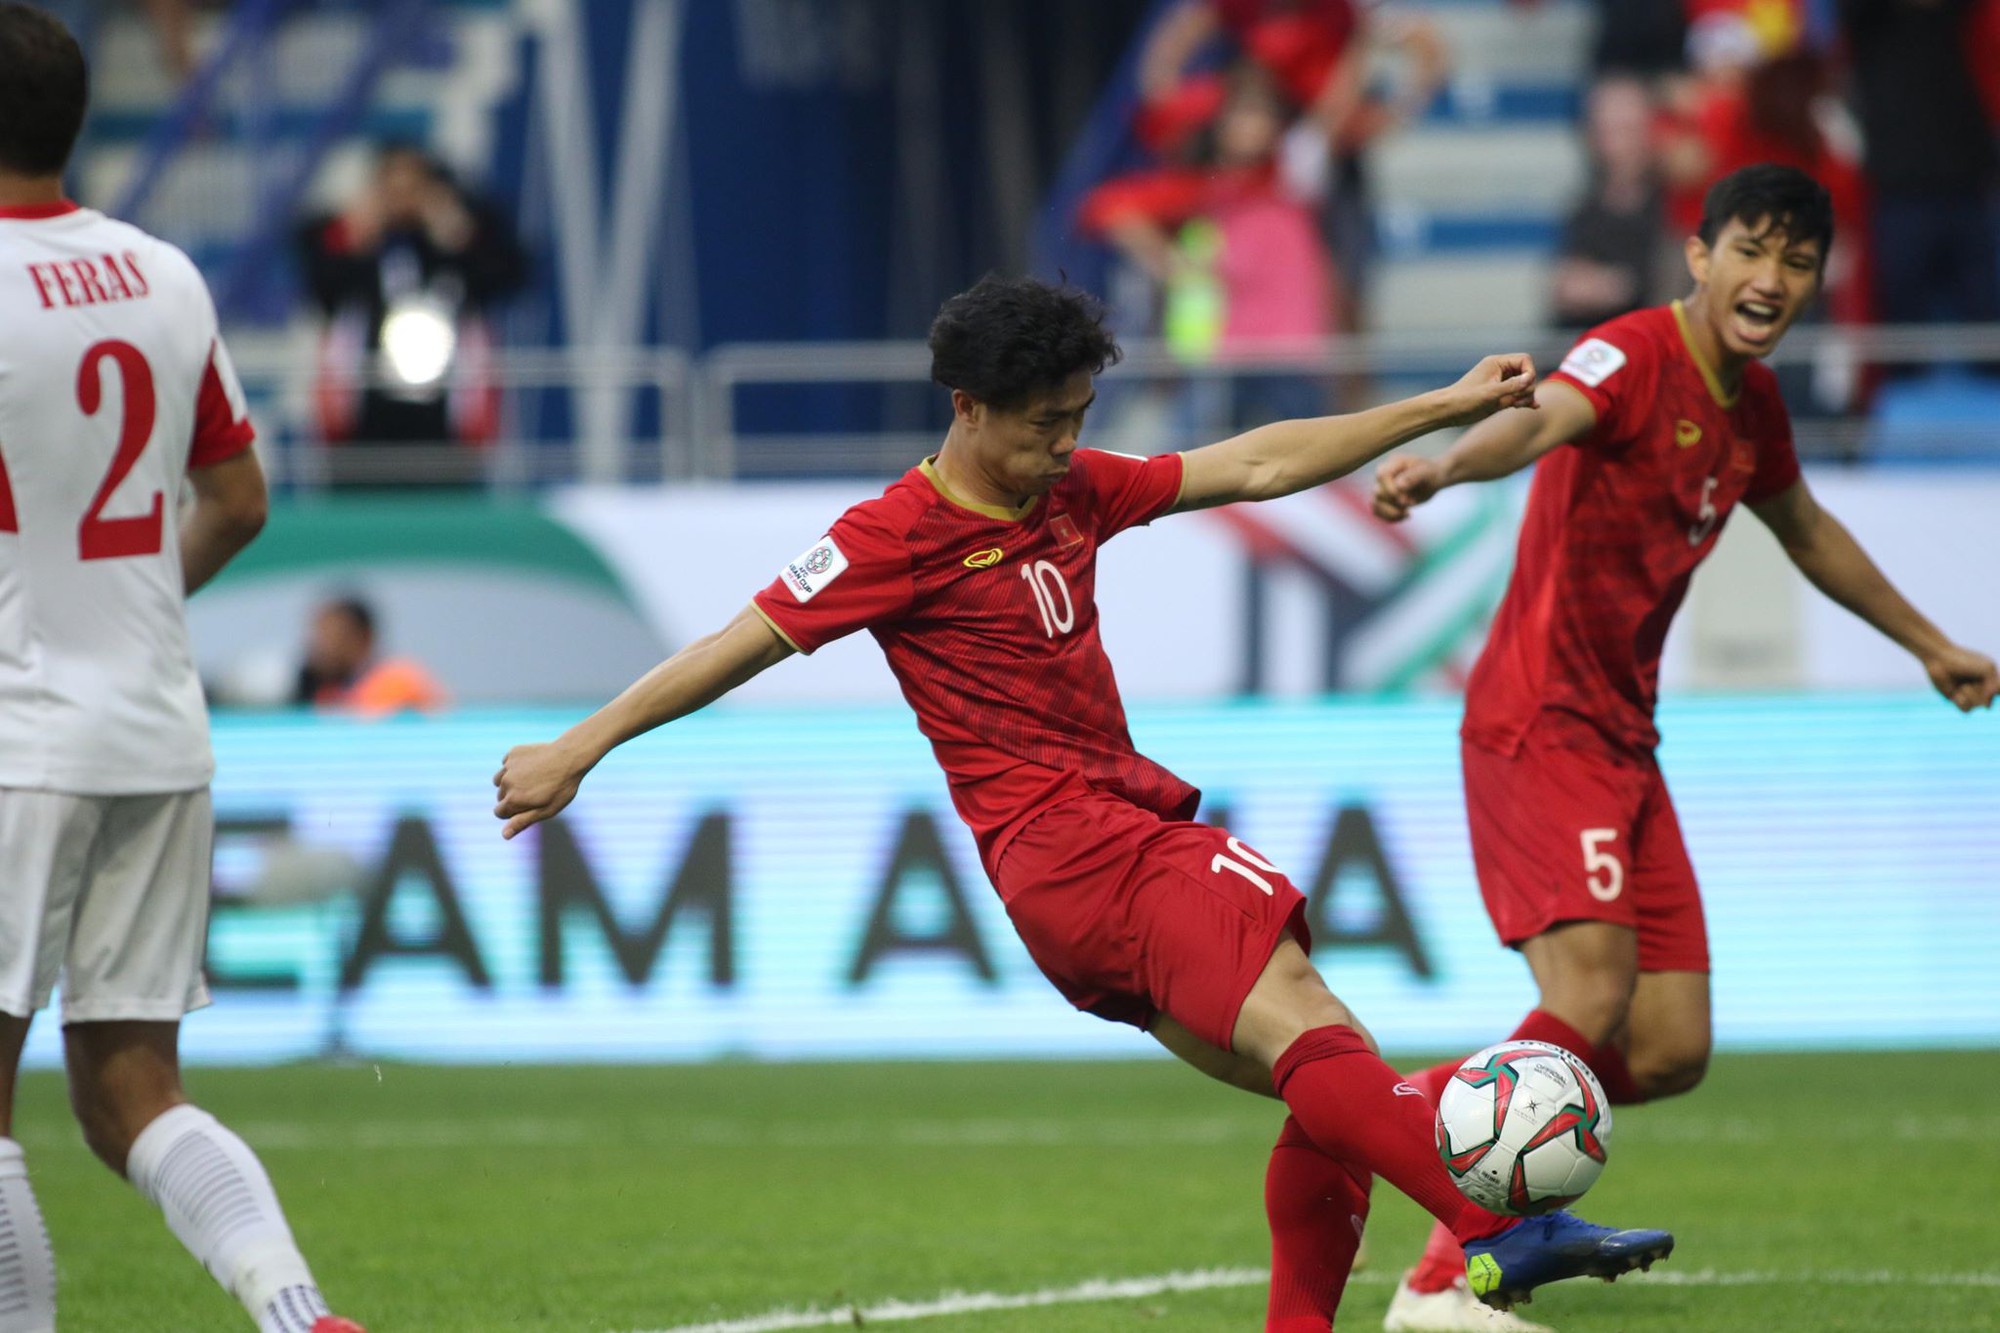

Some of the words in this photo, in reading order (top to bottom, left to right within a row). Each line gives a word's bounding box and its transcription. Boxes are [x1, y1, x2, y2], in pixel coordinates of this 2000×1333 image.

[26, 250, 149, 309] FERAS
[76, 338, 164, 561] 2
[1688, 475, 1719, 546] 5
[799, 578, 813, 593] CUP
[1020, 559, 1075, 639] 10
[1580, 827, 1624, 902] 5
